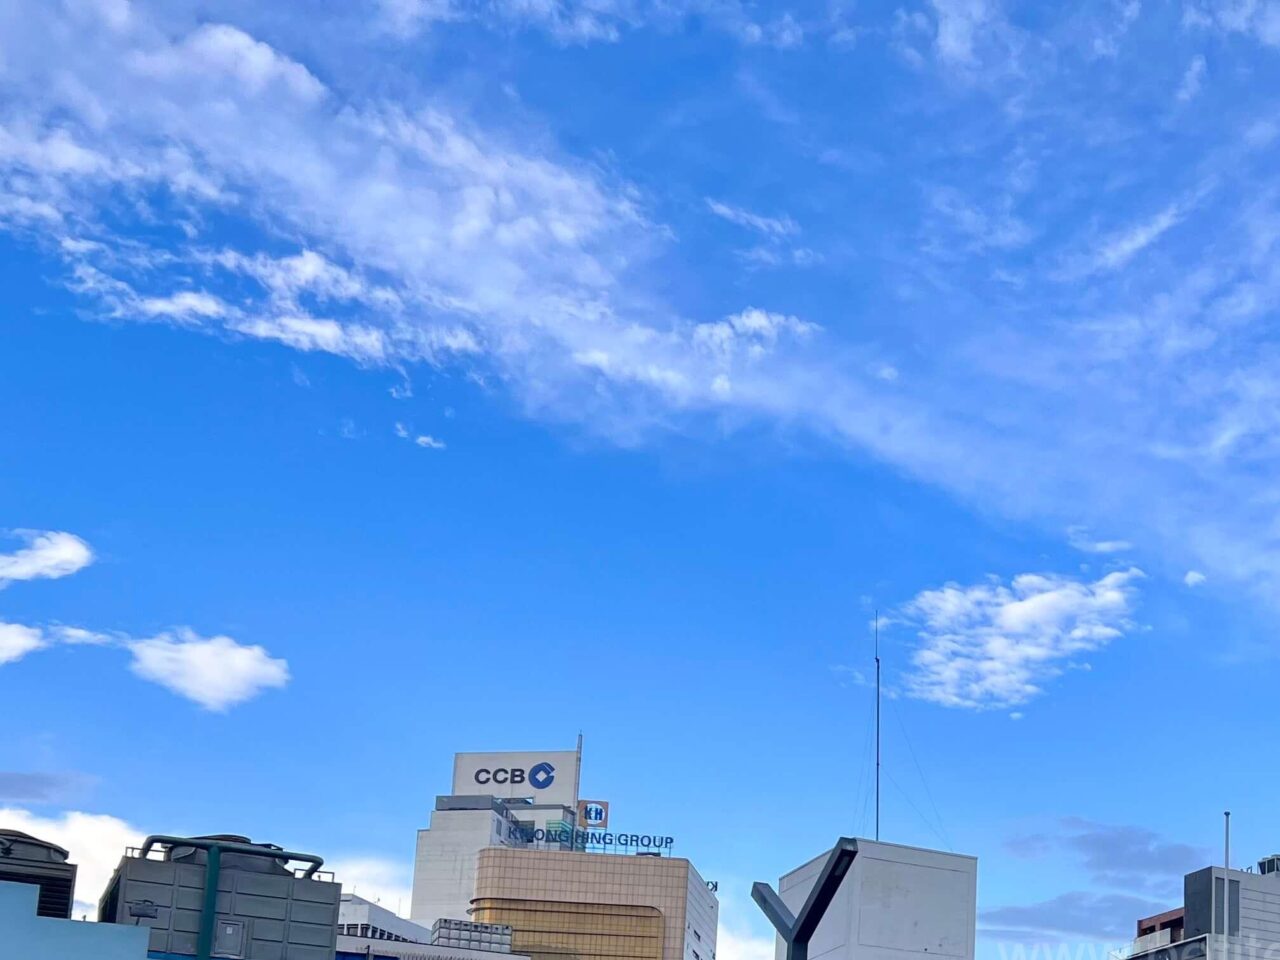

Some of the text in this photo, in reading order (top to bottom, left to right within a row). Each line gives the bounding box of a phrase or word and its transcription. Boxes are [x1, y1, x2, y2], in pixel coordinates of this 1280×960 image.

[474, 768, 526, 785] CCB
[575, 829, 613, 845] HING
[617, 832, 674, 849] GROUP
